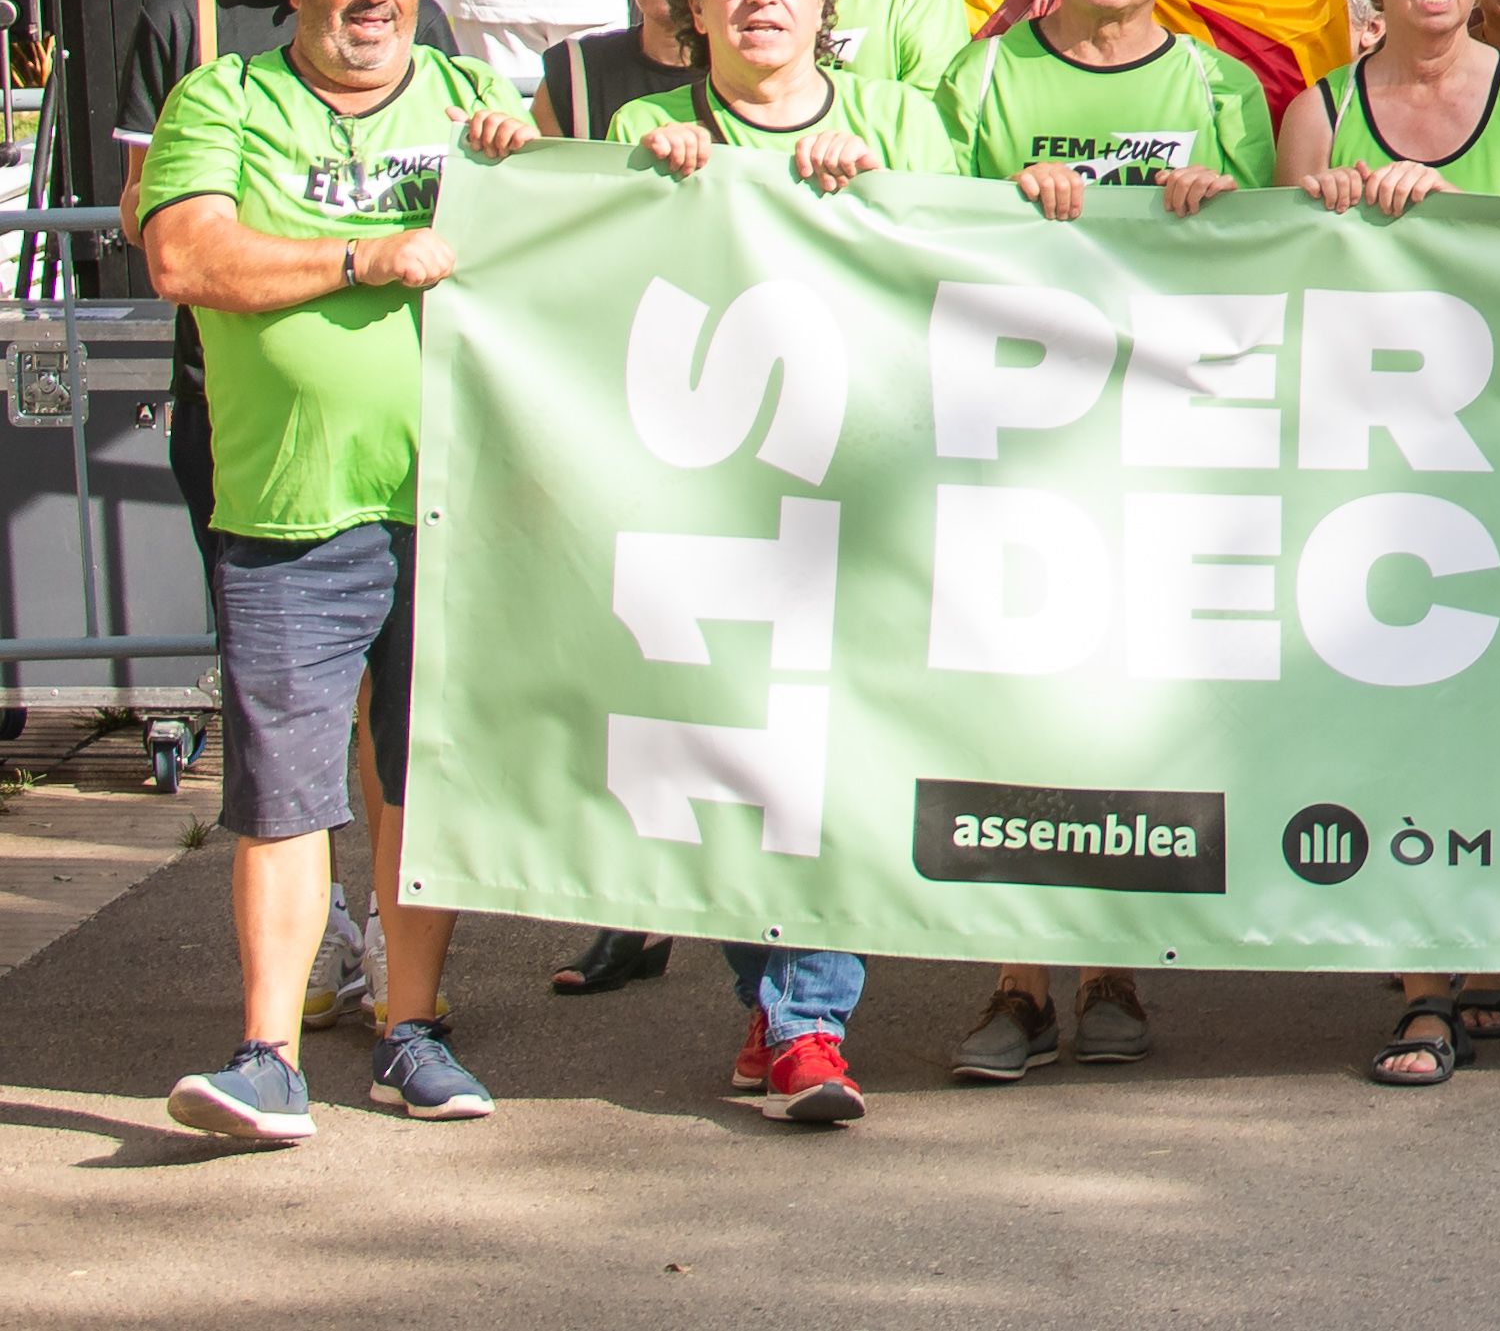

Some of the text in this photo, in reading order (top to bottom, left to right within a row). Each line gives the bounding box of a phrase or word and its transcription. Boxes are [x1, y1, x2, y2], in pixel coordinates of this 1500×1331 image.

[1032, 136, 1096, 159] FEM
[303, 164, 345, 207] EL
[929, 280, 1494, 472] PER
[607, 275, 849, 858] 11S
[952, 813, 1197, 858] assemblea
